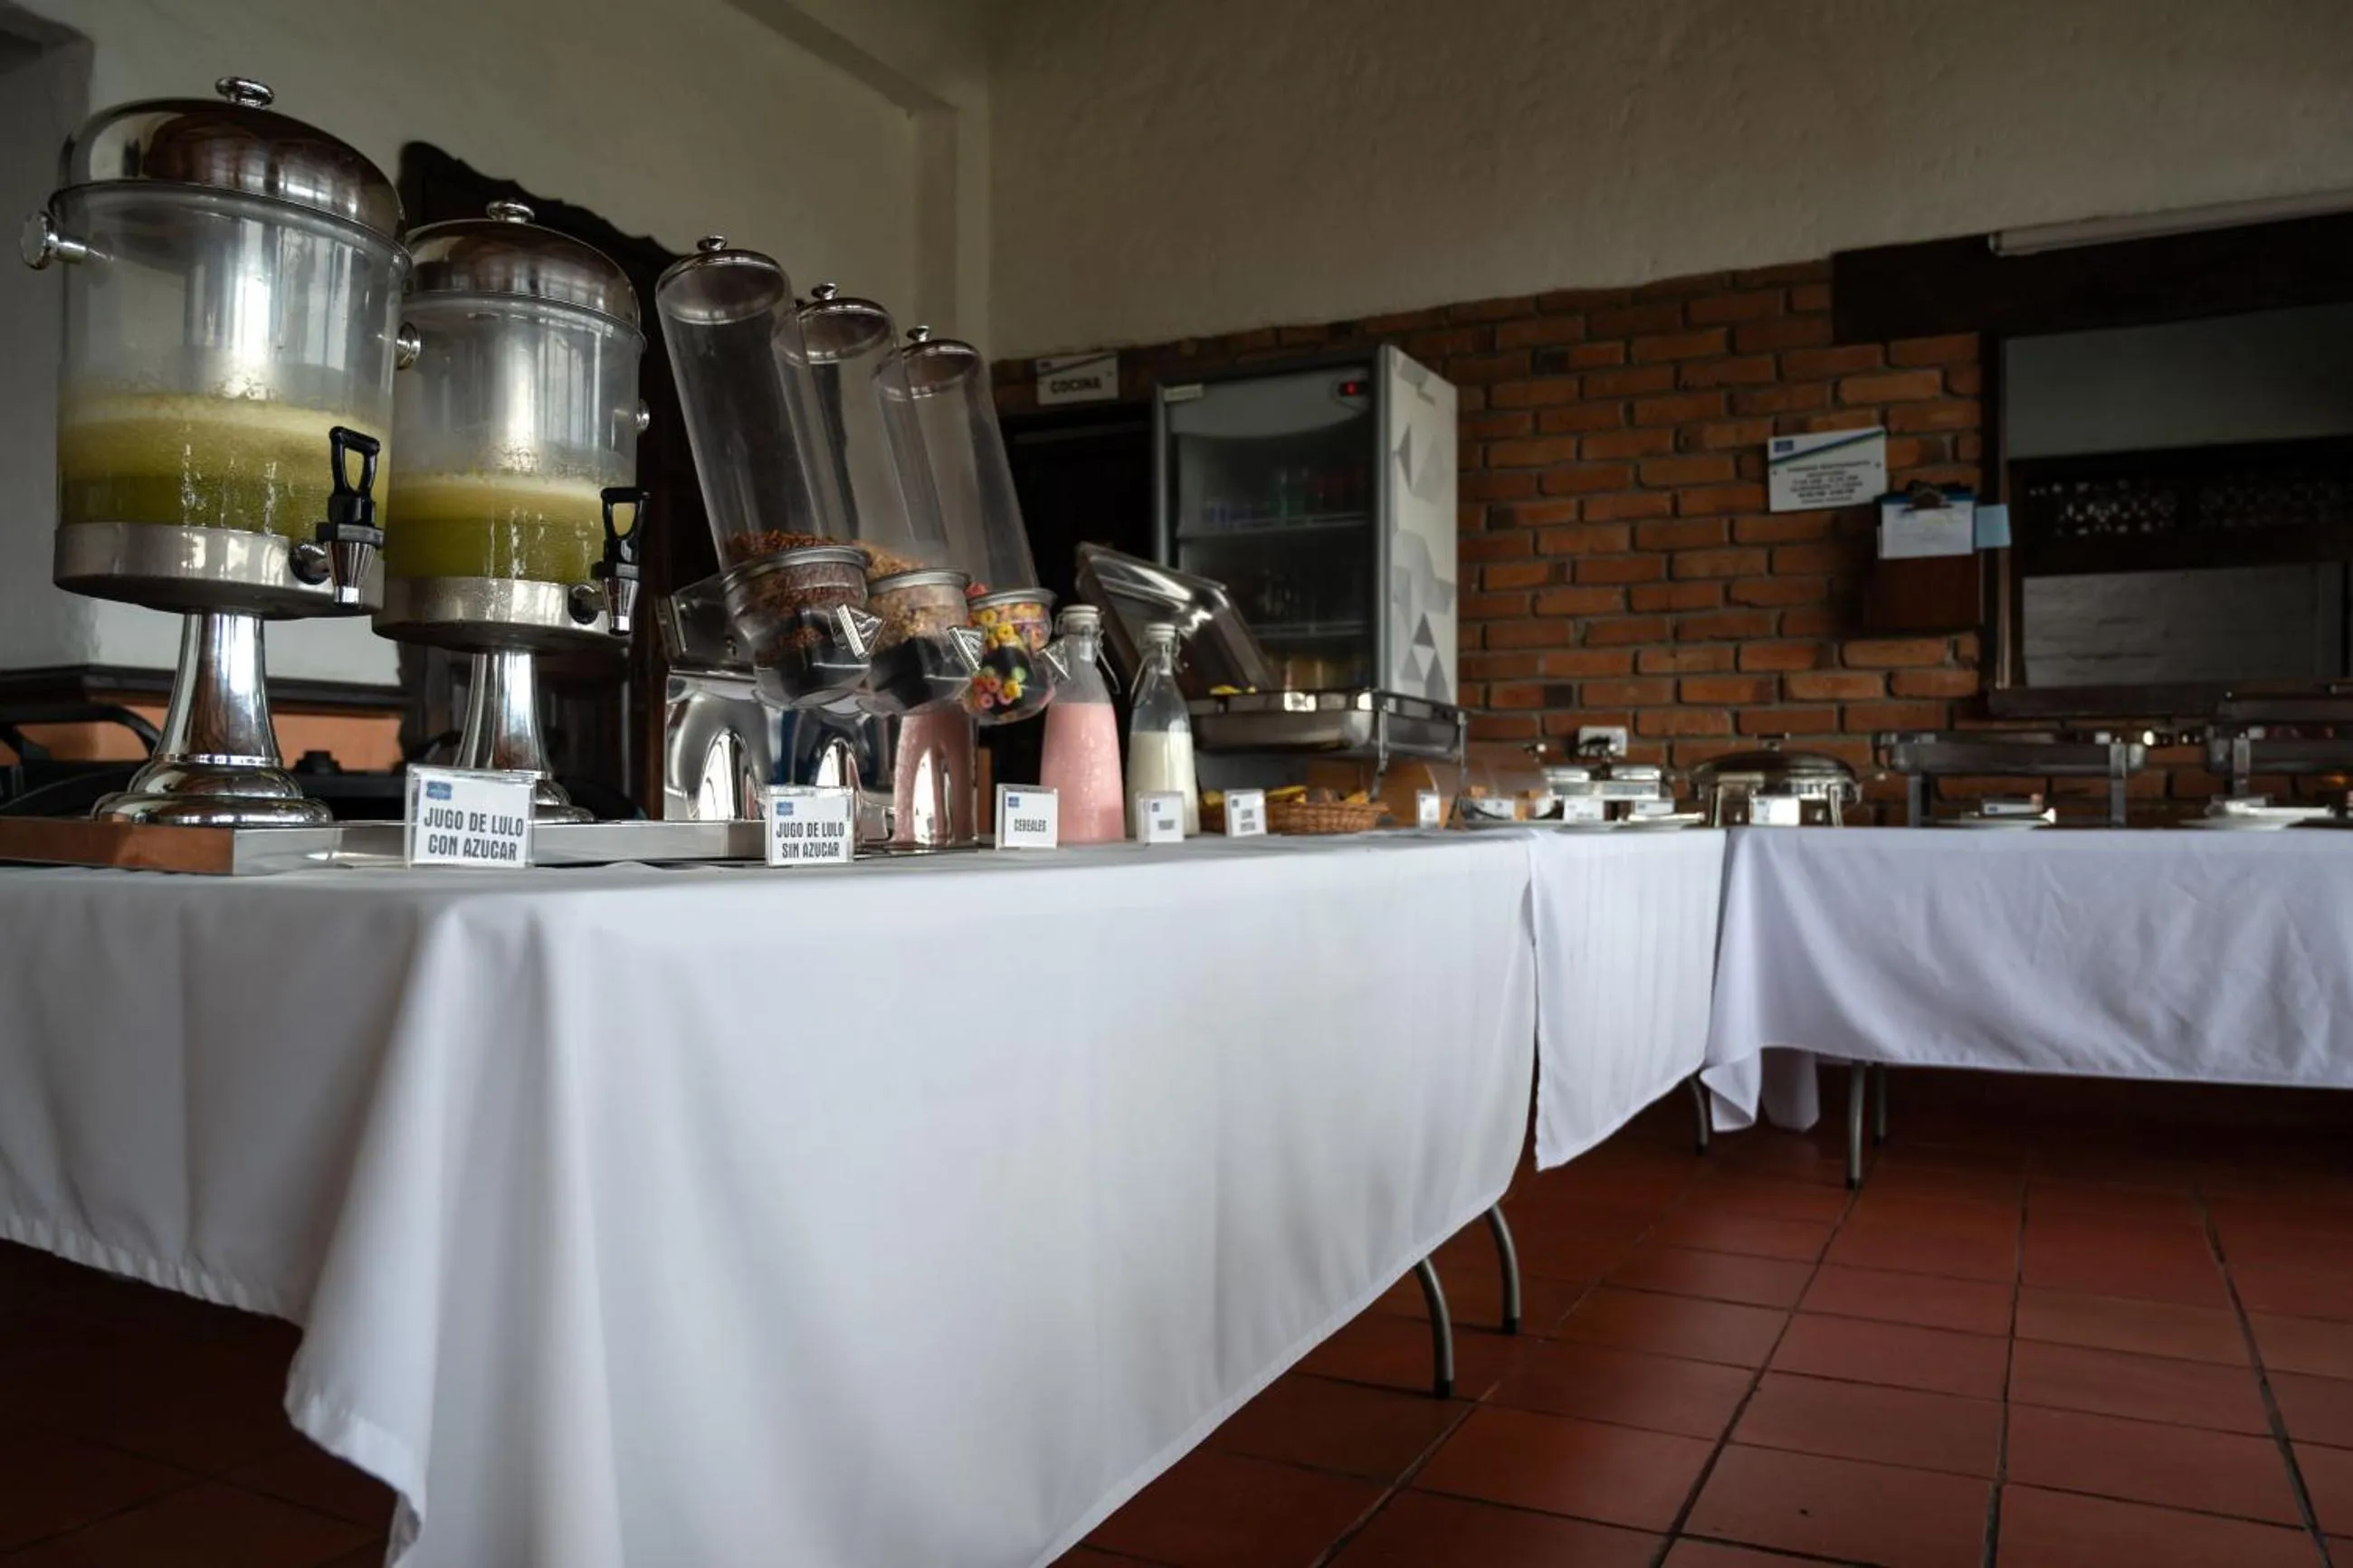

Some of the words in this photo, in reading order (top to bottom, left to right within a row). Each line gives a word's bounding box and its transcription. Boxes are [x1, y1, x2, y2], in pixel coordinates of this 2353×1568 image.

[424, 807, 463, 830] JUGO
[469, 812, 487, 832] DE
[491, 815, 524, 837] LULO
[776, 822, 804, 838] JUGO
[807, 822, 819, 838] DE
[822, 822, 844, 838] LULO
[428, 834, 458, 856] CON
[463, 838, 517, 861] AZUCAR
[782, 842, 799, 858] SIN
[803, 841, 840, 858] AZUCAR
